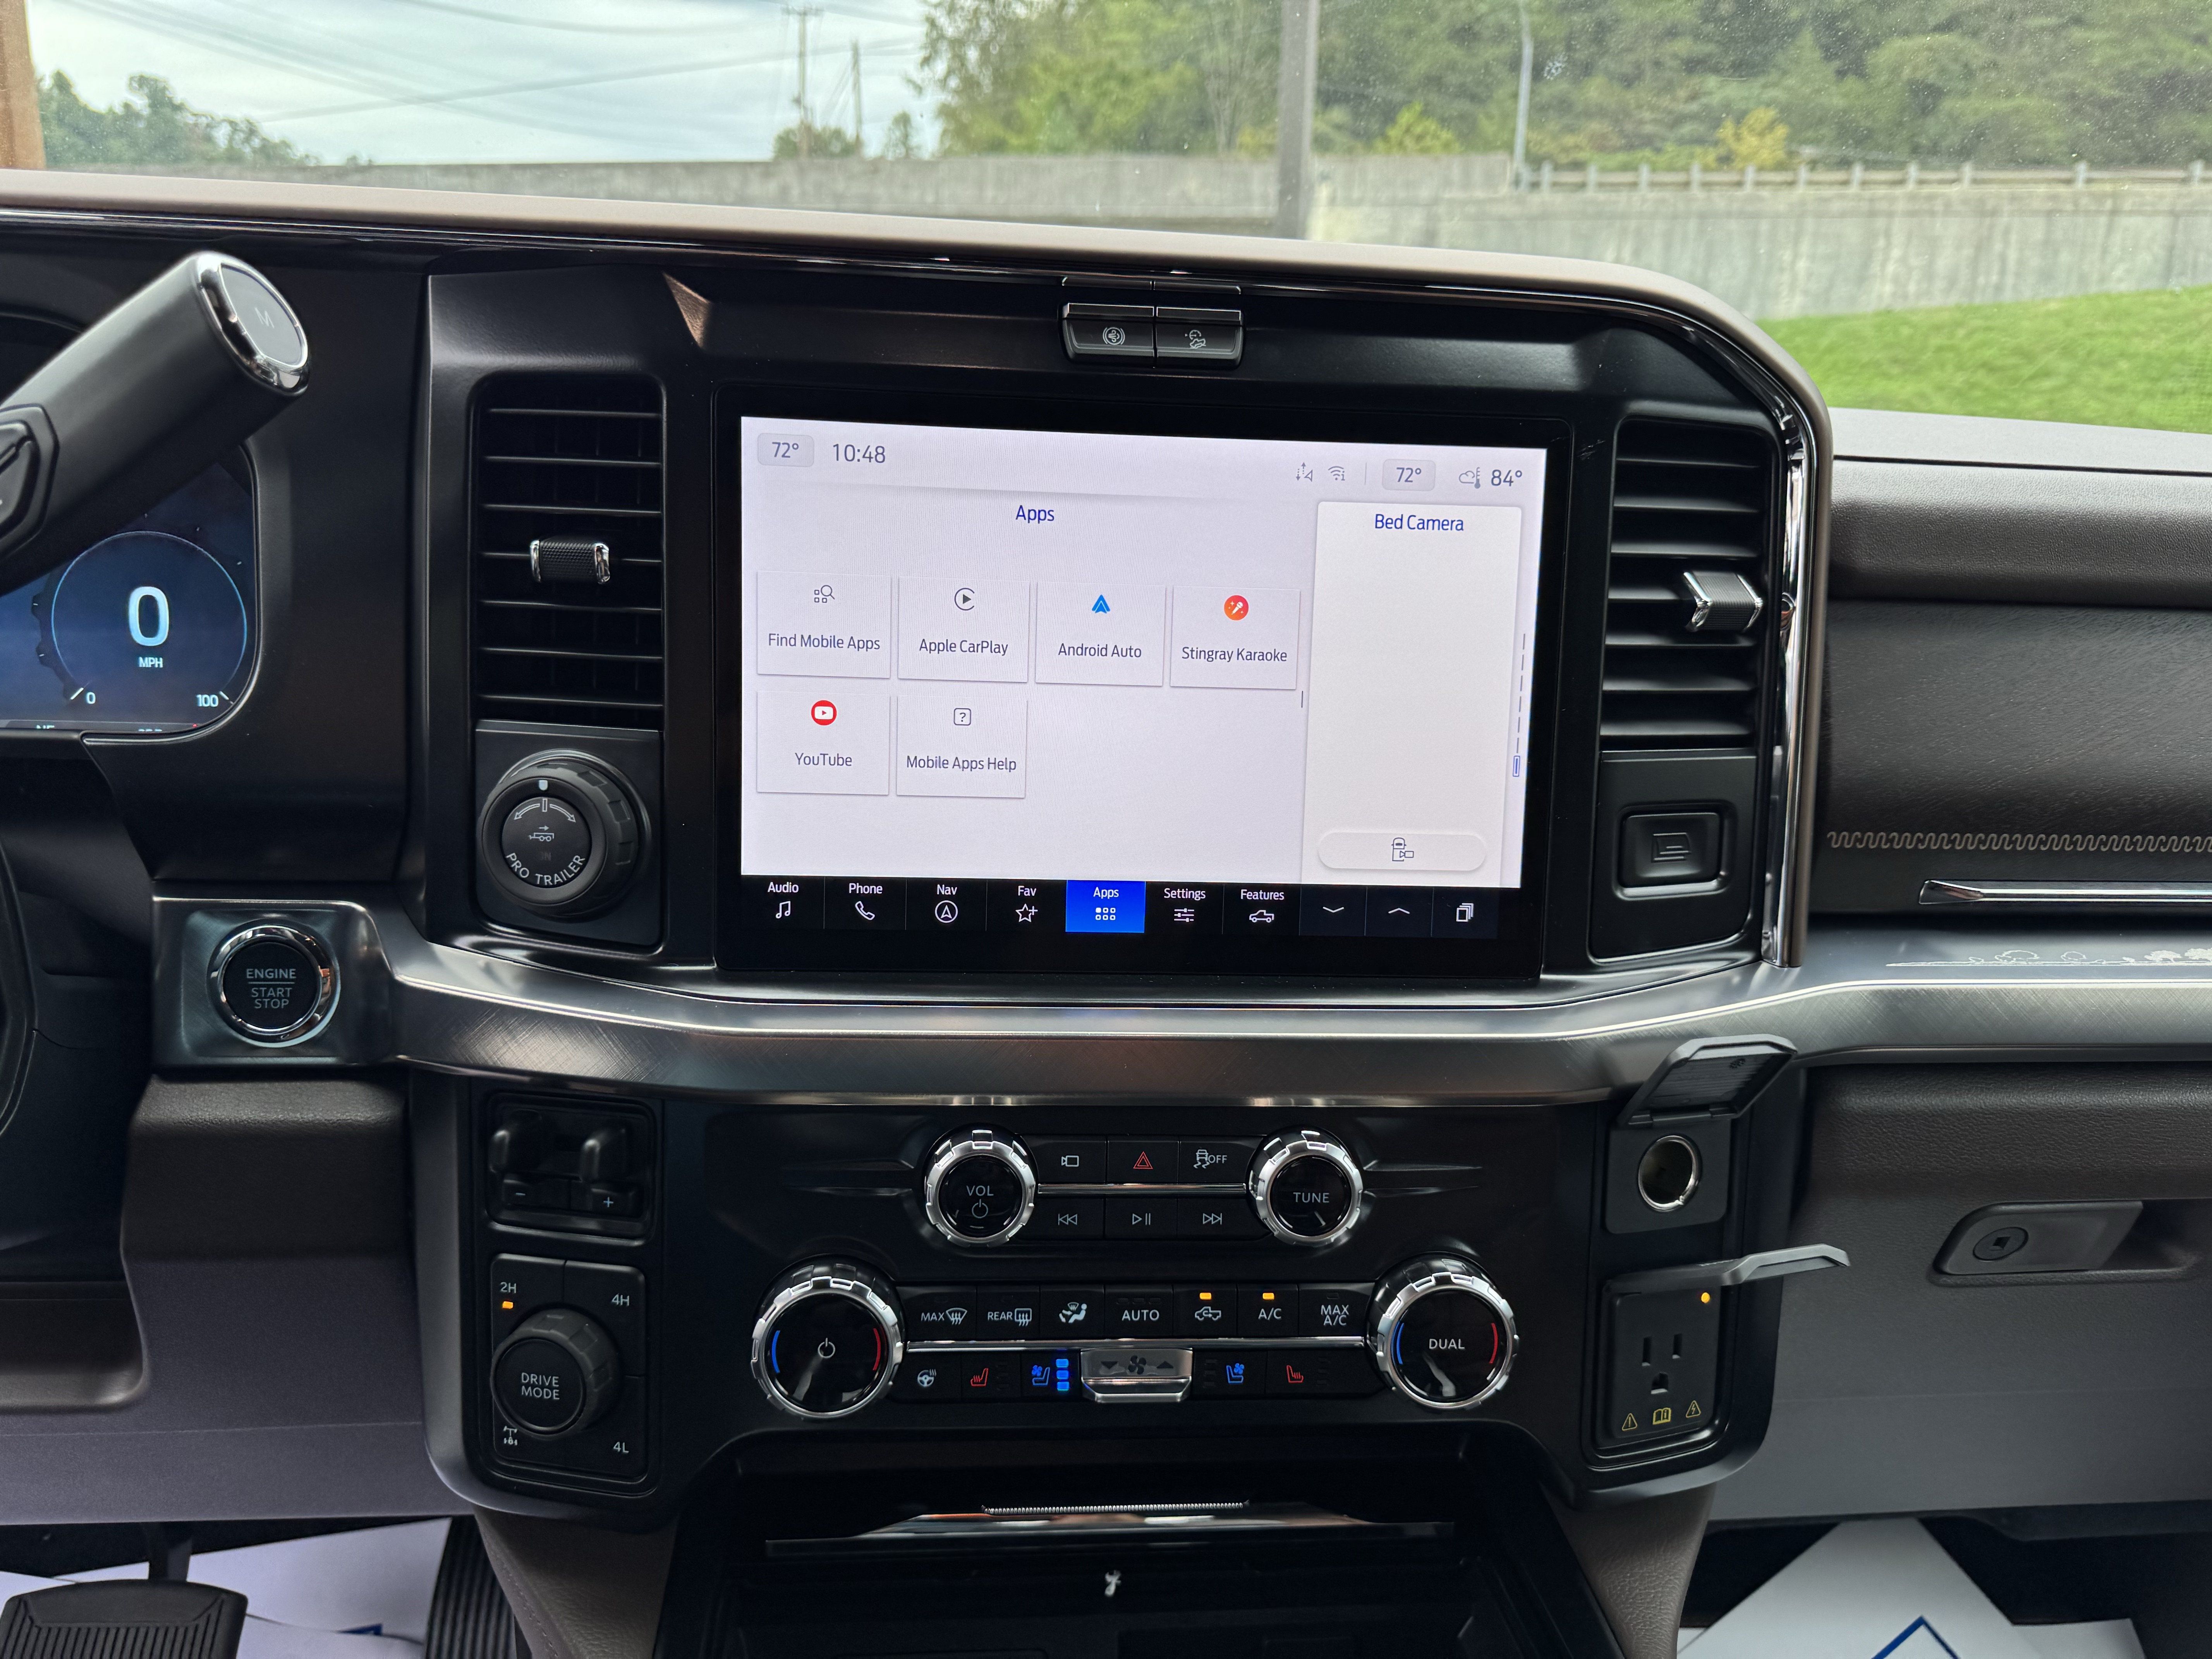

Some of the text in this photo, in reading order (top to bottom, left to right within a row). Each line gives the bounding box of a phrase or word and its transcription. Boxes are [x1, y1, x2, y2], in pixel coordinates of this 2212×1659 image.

[772, 442, 799, 458] 72°
[833, 443, 886, 463] 10:48
[1396, 467, 1422, 483] 72°
[1491, 469, 1522, 487] 84°
[1015, 505, 1054, 524] Apps
[1375, 514, 1464, 531] Bed Camera
[128, 586, 169, 646] 0
[769, 633, 880, 652] Find Mobile Apps
[919, 639, 1008, 656] Apple CarPlay
[1058, 643, 1142, 658] Android Auto
[1182, 646, 1287, 663] Stingray Karaoke
[139, 657, 163, 668] MPH
[86, 692, 96, 704] 0
[197, 694, 218, 707] 100
[795, 752, 852, 766] YouTube
[907, 755, 1016, 773] Mobile Apps Help
[506, 852, 586, 886] PRO TRAILER
[768, 881, 799, 893] Audio
[849, 883, 883, 894] Phone
[937, 884, 957, 895] Nav
[1018, 885, 1037, 896] Fav
[1093, 886, 1119, 899] Apps
[1164, 888, 1206, 901] Settings
[1241, 889, 1285, 900] Features
[246, 968, 296, 979] ENGINE
[251, 988, 292, 998] START
[254, 998, 289, 1009] STOP
[1209, 1155, 1227, 1164] OFF
[966, 1185, 994, 1196] VOL
[1293, 1192, 1329, 1203] TUNE
[500, 1282, 516, 1293] 2H
[611, 1294, 629, 1306] 4H
[988, 1311, 1013, 1321] REAR
[1121, 1309, 1159, 1321] AUTO
[1258, 1307, 1281, 1320] A/C
[1321, 1305, 1349, 1315] MAX
[921, 1312, 945, 1321] MAX
[1323, 1314, 1346, 1326] A/C
[1429, 1338, 1465, 1349] DUAL
[521, 1372, 559, 1387] DRIVE
[522, 1386, 560, 1400] MODE
[613, 1441, 629, 1453] 4L
